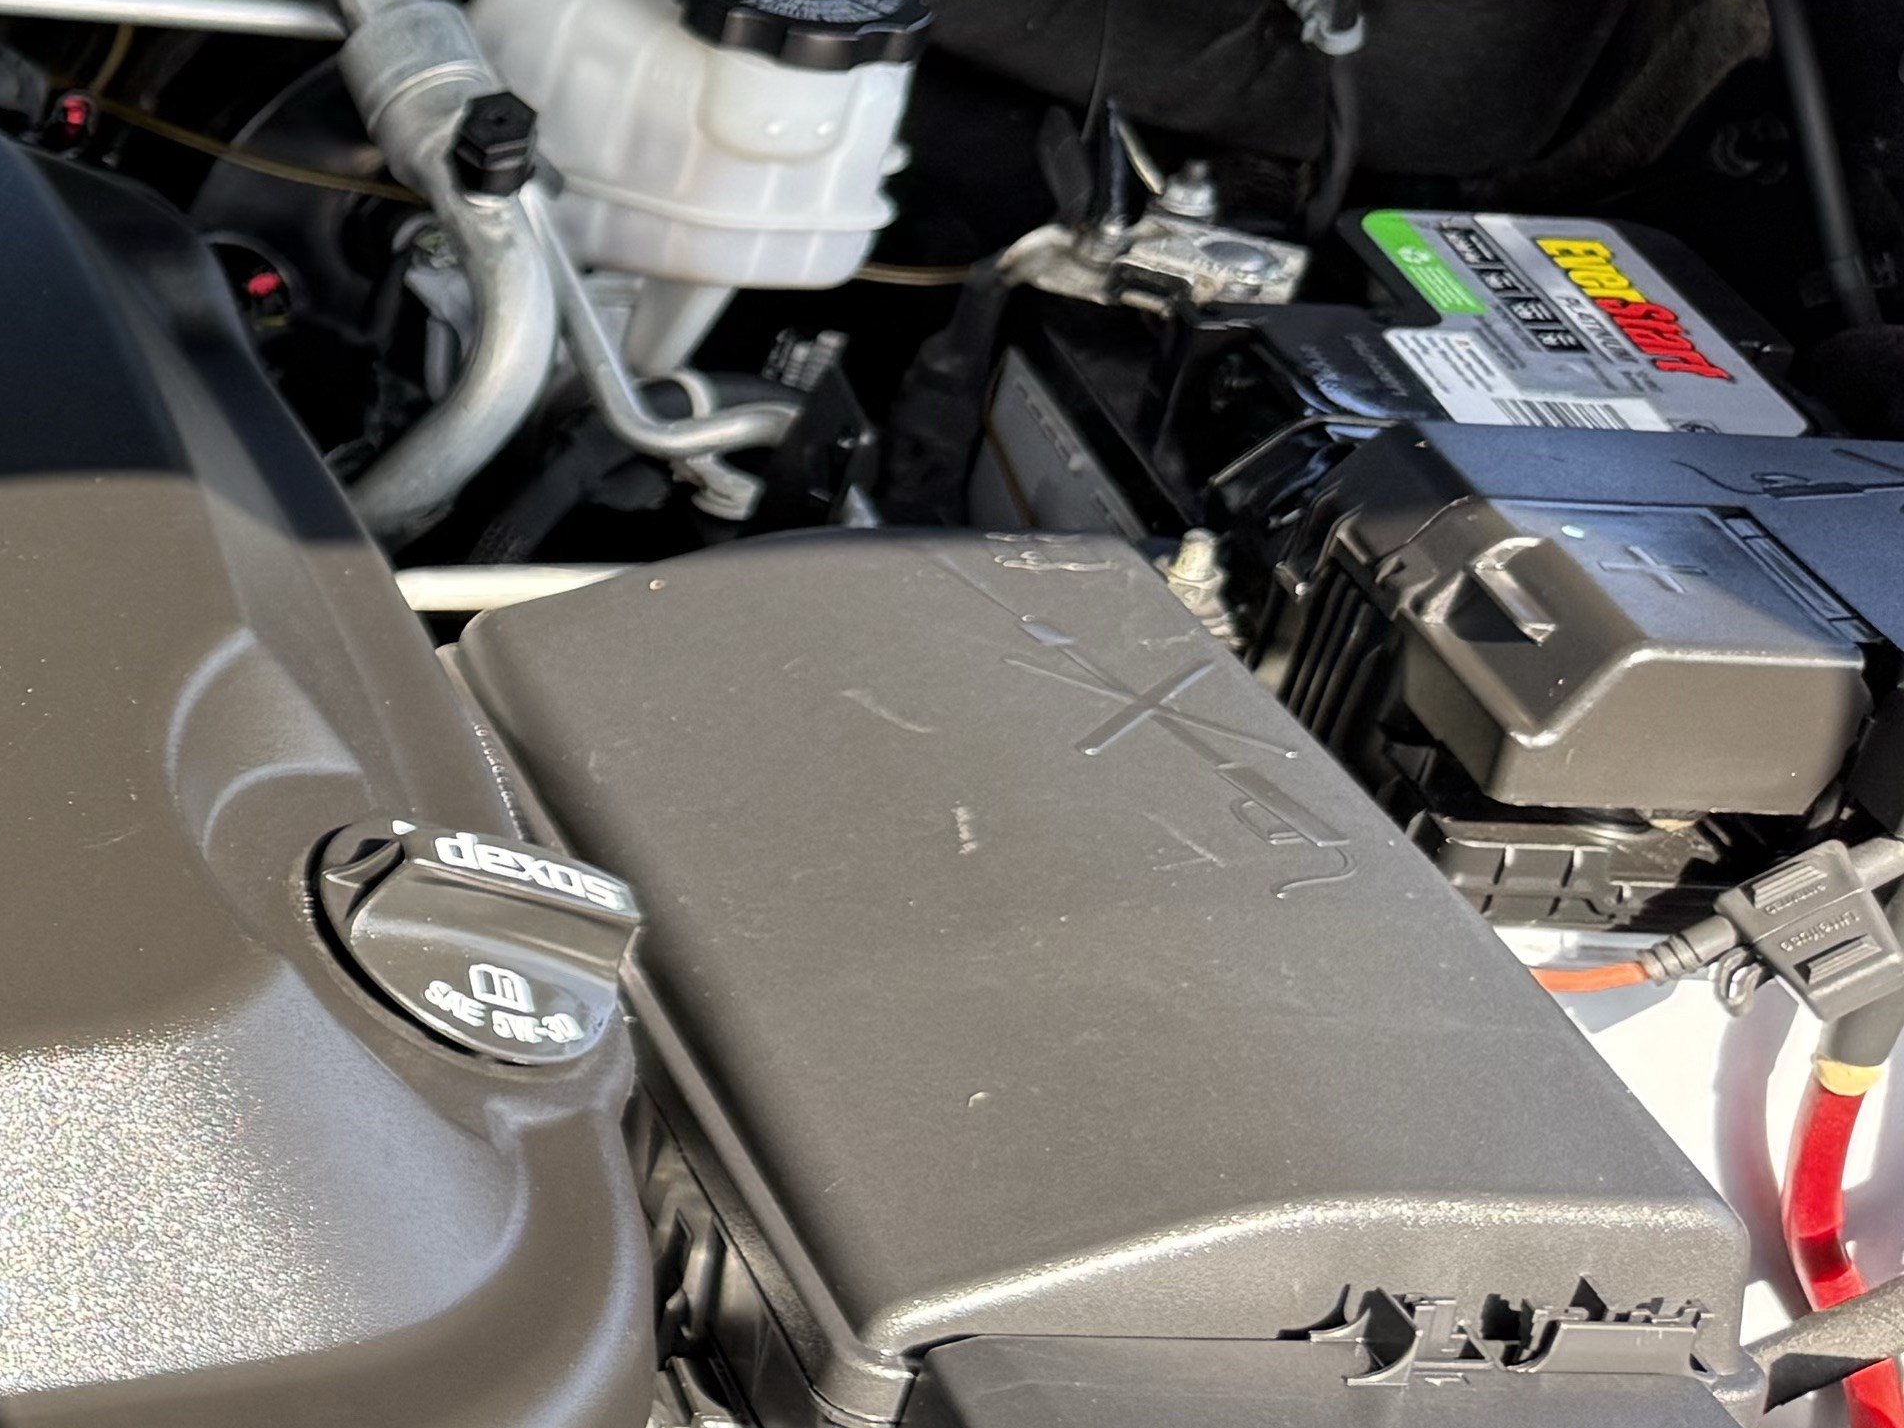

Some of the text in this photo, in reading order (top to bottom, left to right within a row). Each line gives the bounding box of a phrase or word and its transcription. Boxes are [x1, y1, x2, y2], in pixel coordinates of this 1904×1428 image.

[1536, 236, 1734, 381] EverStart
[434, 832, 624, 911] dexos
[424, 979, 584, 1044] SAE 5W-30
